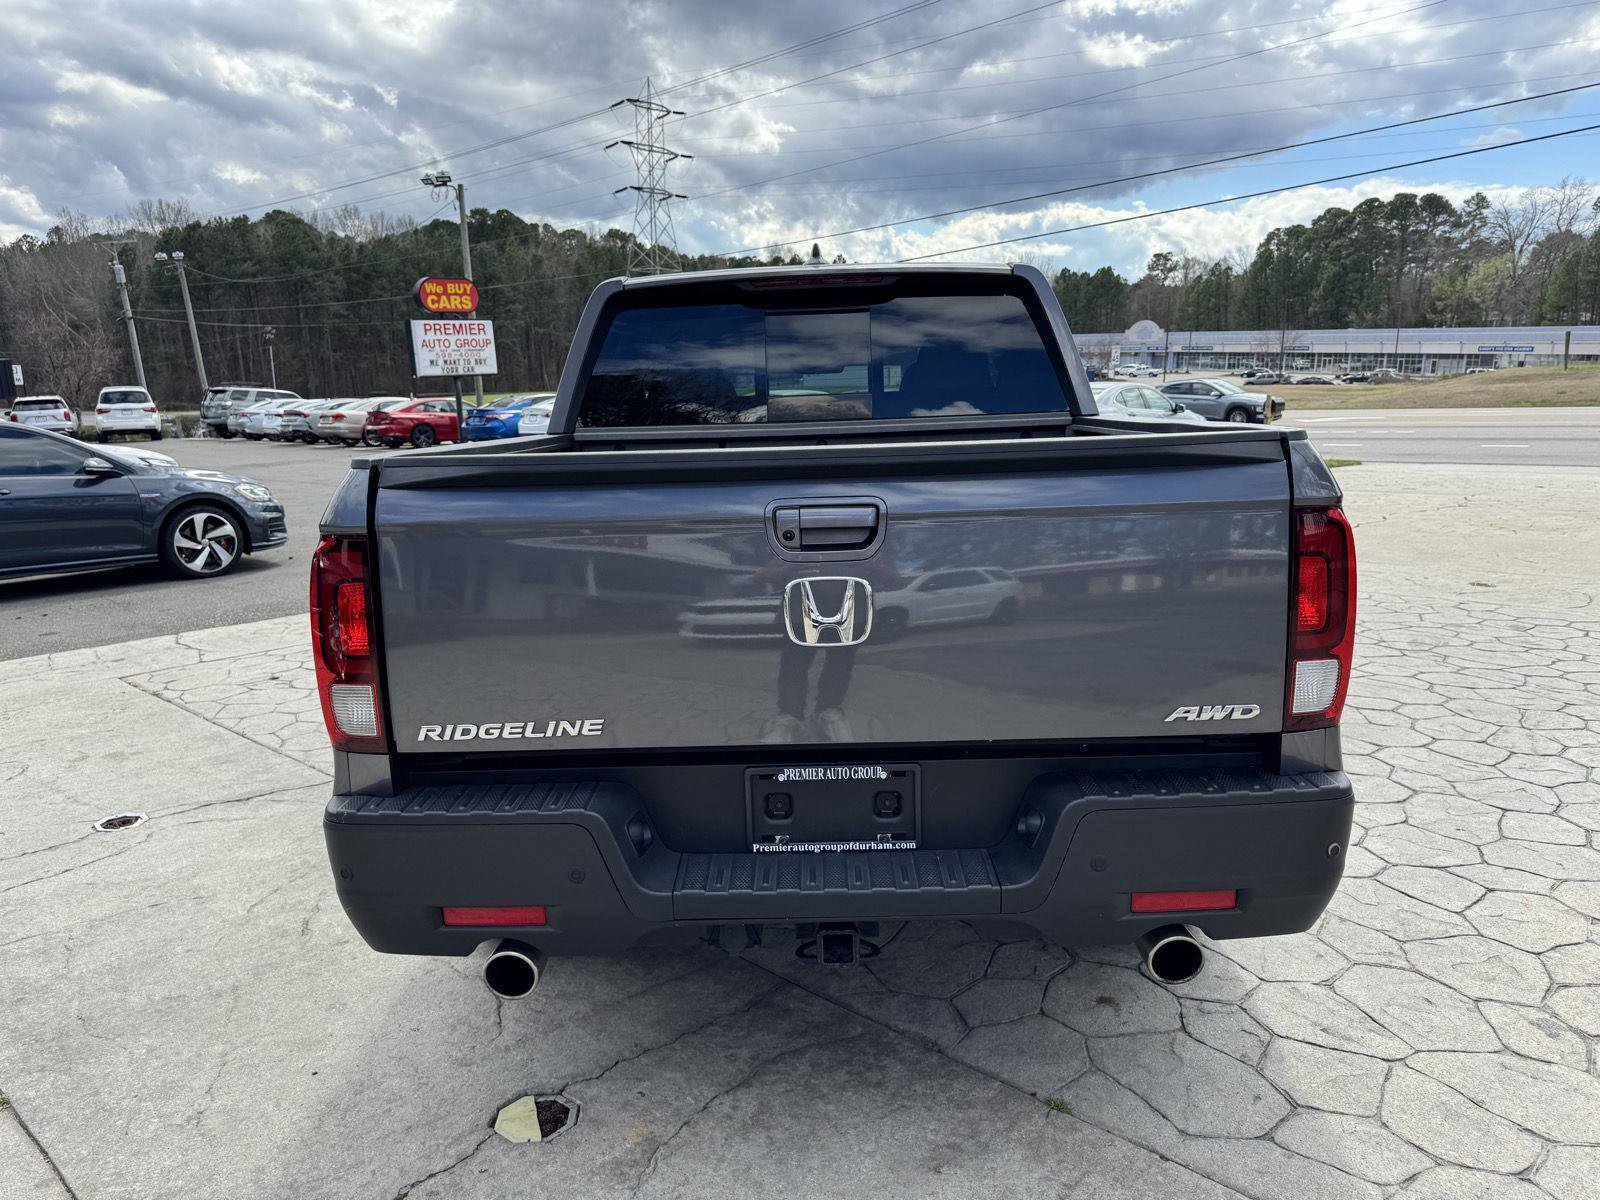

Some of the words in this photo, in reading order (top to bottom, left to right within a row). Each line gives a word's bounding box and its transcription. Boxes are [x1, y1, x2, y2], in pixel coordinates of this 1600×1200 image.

[424, 282, 443, 293] We
[447, 283, 472, 294] BUY
[427, 295, 473, 309] CARS
[423, 323, 486, 336] PREMIER
[421, 338, 451, 349] AUTO
[455, 338, 492, 349] GROUP
[474, 358, 487, 366] BUY
[1163, 704, 1261, 722] AWD
[417, 718, 605, 742] RIDGELINE
[783, 768, 823, 781] PREMIER
[825, 767, 848, 780] AUTO
[851, 766, 882, 779] GROUP
[752, 841, 917, 853] Premierautogroupofdurham.com
